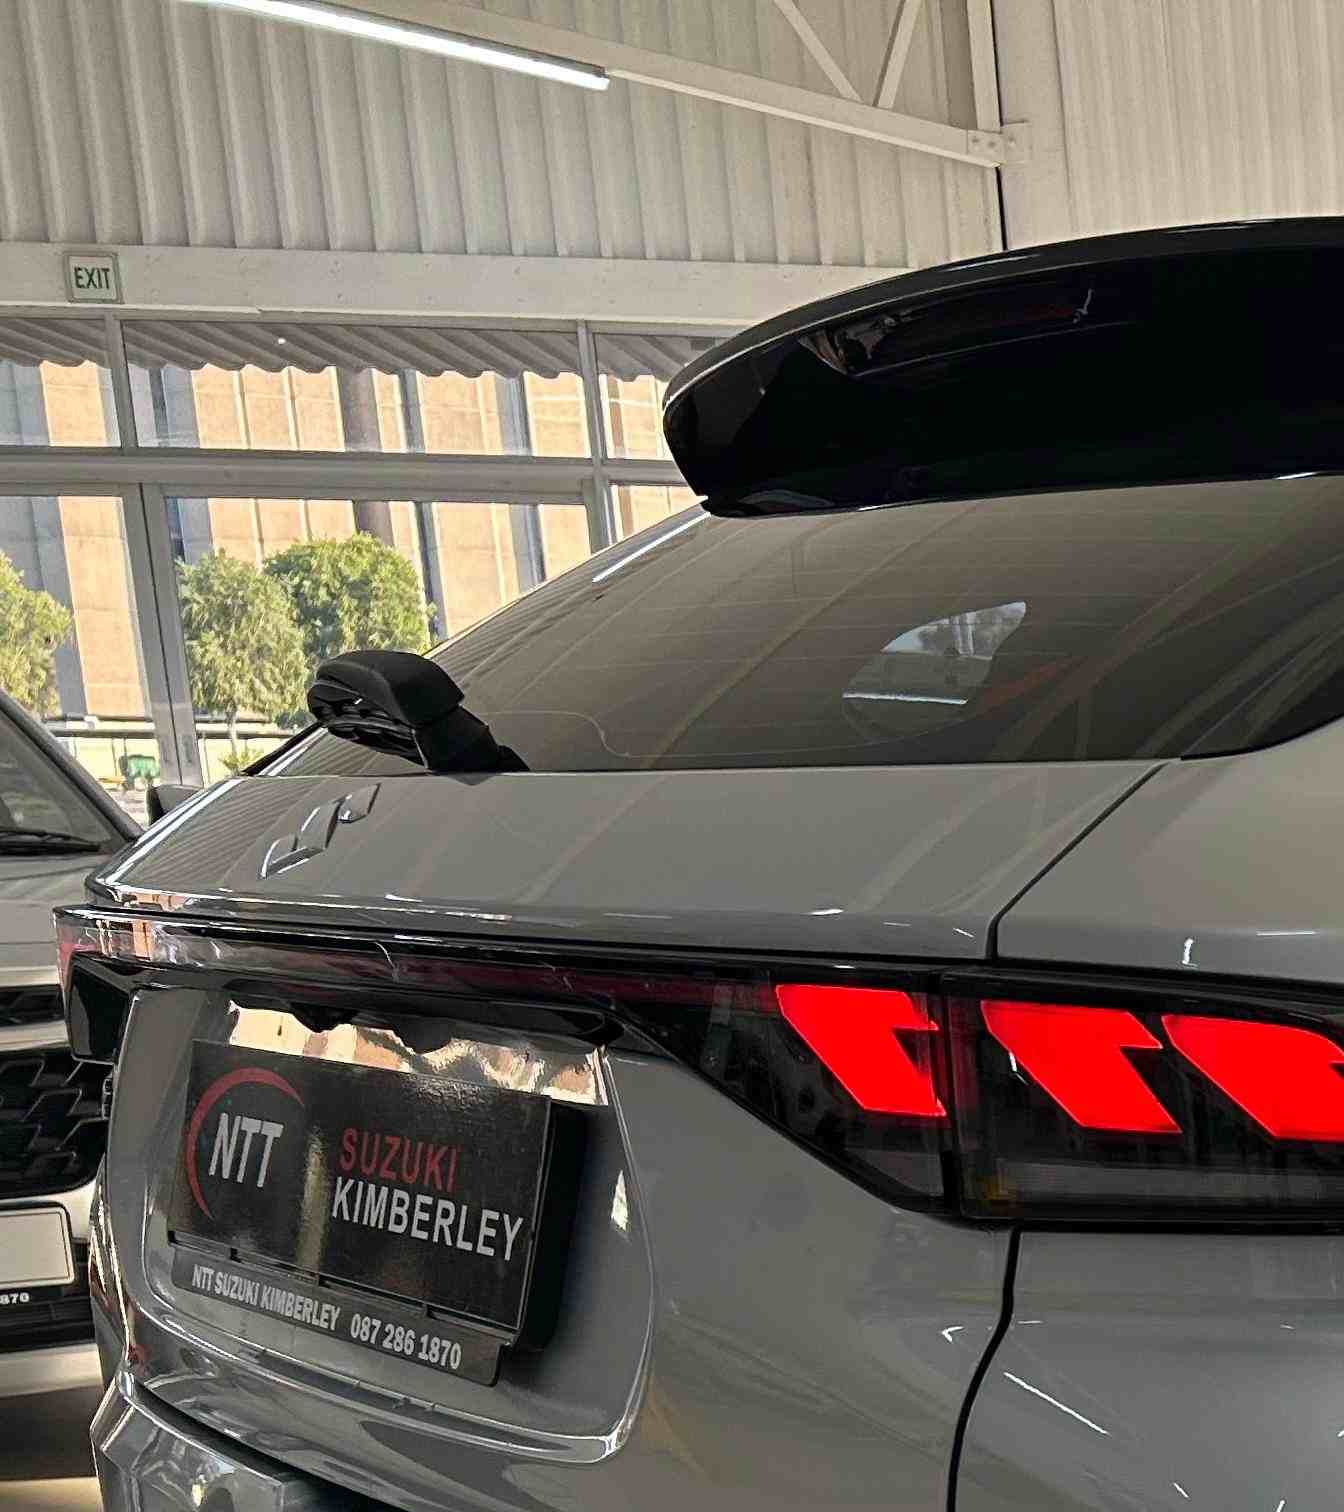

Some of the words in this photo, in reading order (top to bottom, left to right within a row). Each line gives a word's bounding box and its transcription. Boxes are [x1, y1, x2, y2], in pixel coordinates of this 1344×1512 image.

[74, 267, 110, 290] EXIT
[207, 1113, 285, 1188] NTT
[338, 1128, 463, 1193] SUZUKI
[331, 1176, 525, 1262] KIMBERLEY
[190, 1263, 216, 1291] NTT
[213, 1271, 261, 1307] SUZUKI
[259, 1282, 342, 1332] KIMBERLEY
[349, 1313, 382, 1345] 087
[381, 1323, 417, 1356] 286
[417, 1333, 463, 1370] 1870
